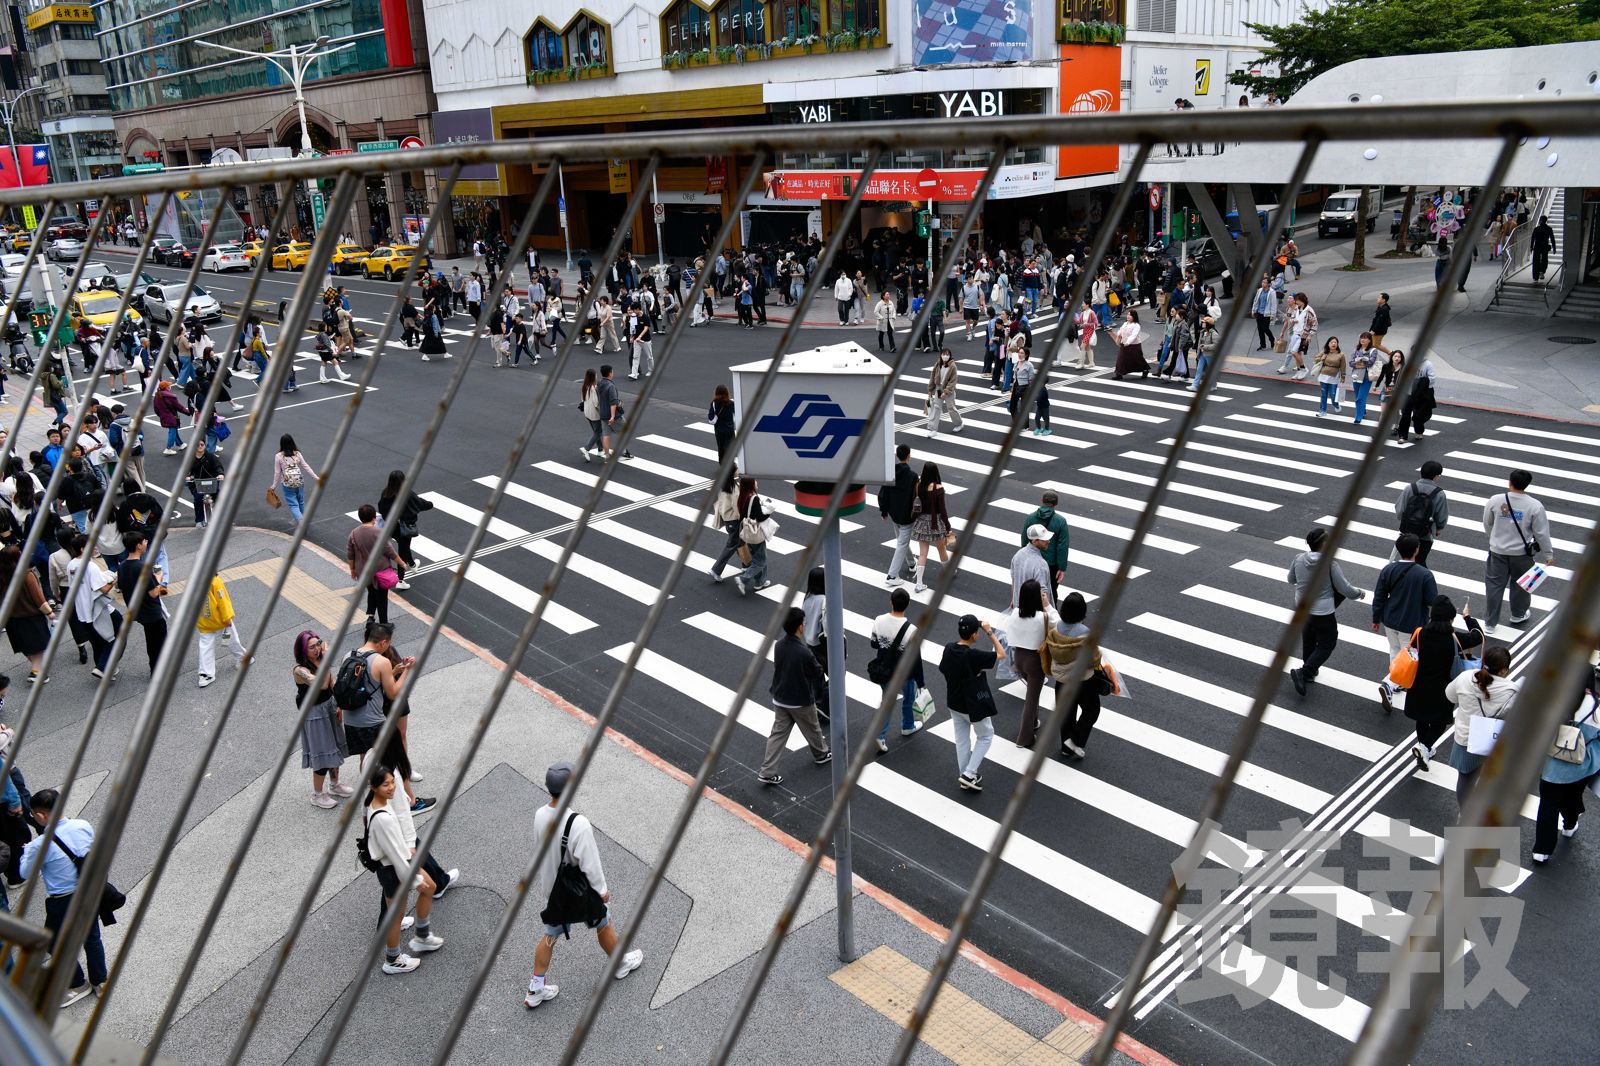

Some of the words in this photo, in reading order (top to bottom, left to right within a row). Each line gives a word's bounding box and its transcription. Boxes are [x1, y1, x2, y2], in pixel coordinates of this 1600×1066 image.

[939, 91, 1003, 118] YABI
[800, 105, 831, 123] YABI
[32, 314, 48, 328] 31
